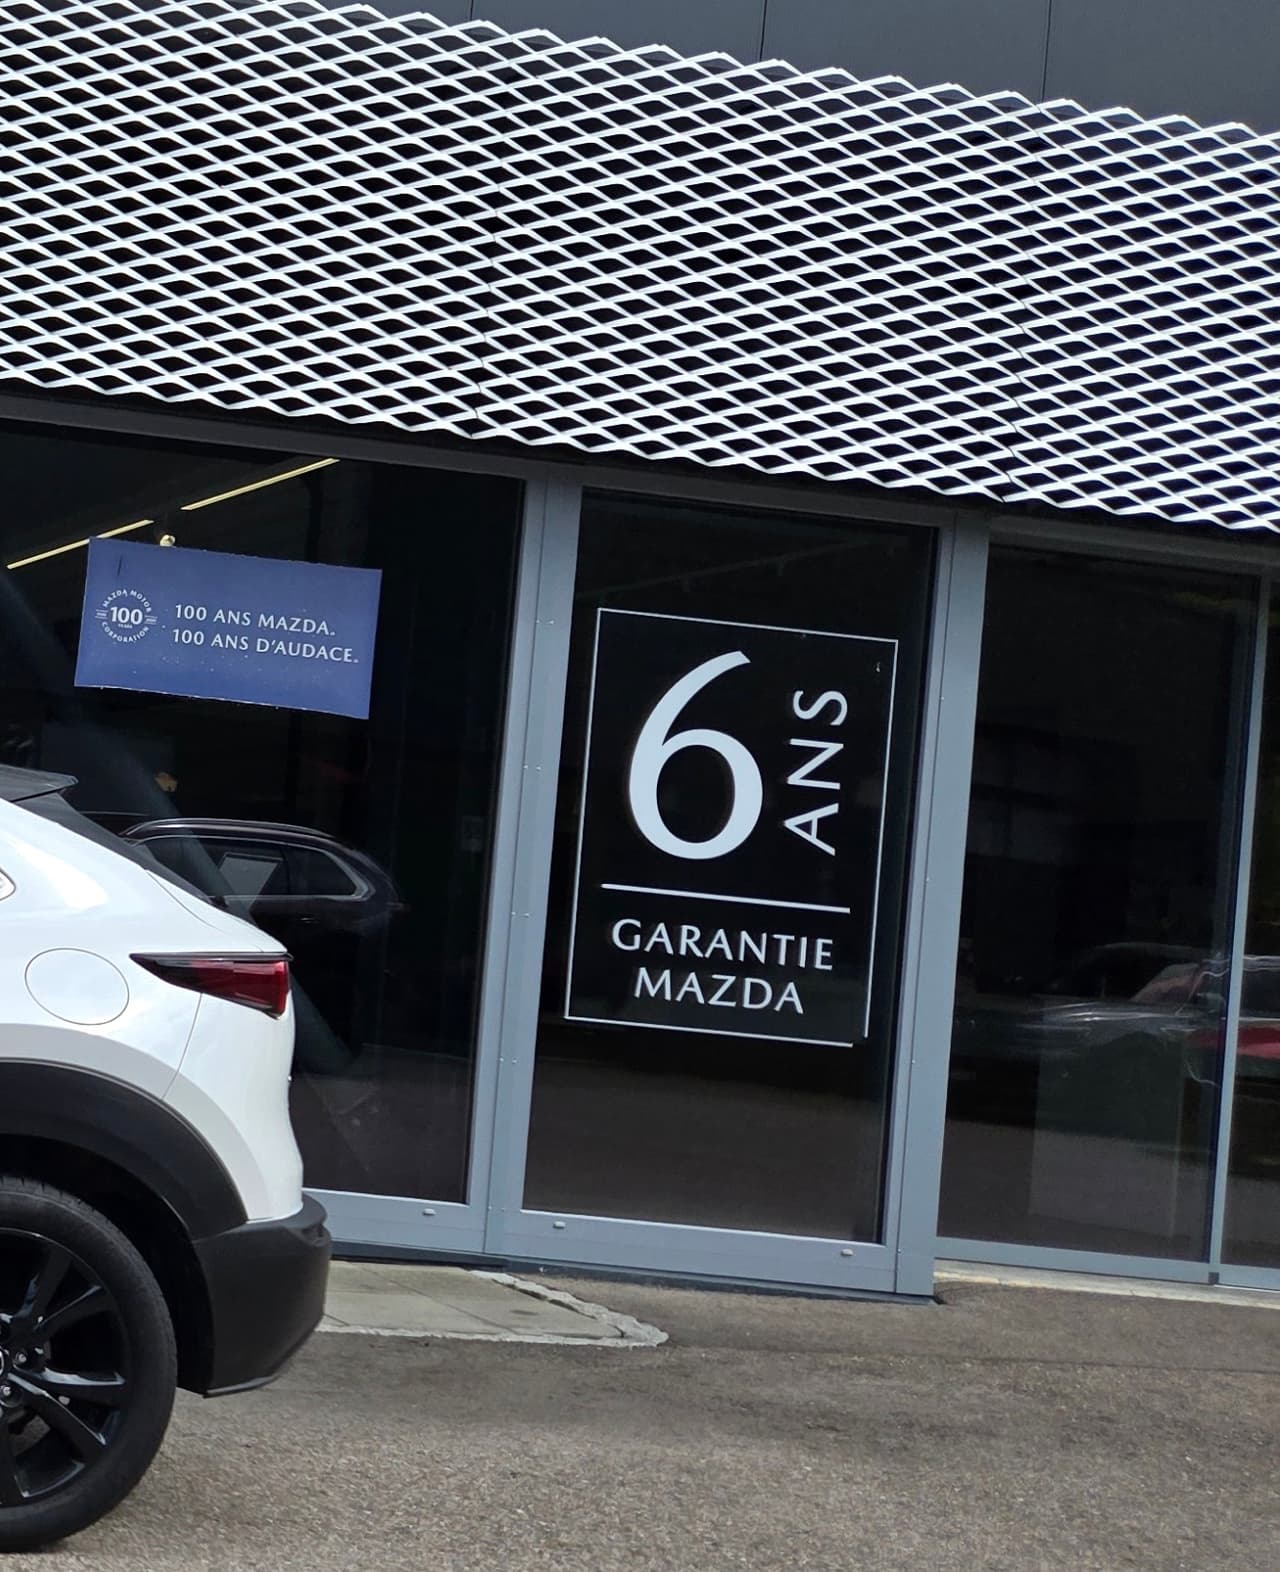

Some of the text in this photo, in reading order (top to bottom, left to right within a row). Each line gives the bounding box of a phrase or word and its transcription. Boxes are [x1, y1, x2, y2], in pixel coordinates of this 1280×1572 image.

[102, 588, 152, 613] MAZDA MOTOR
[110, 606, 143, 625] 100
[101, 621, 149, 643] CORPORATION
[175, 604, 336, 636] 100 ANS MAZDA.
[172, 628, 359, 663] 100 ANS D'AUDACE.
[628, 650, 763, 859] 6
[784, 690, 848, 856] ANS
[611, 918, 834, 970] GARANTIE
[633, 967, 804, 1014] MAZDA
